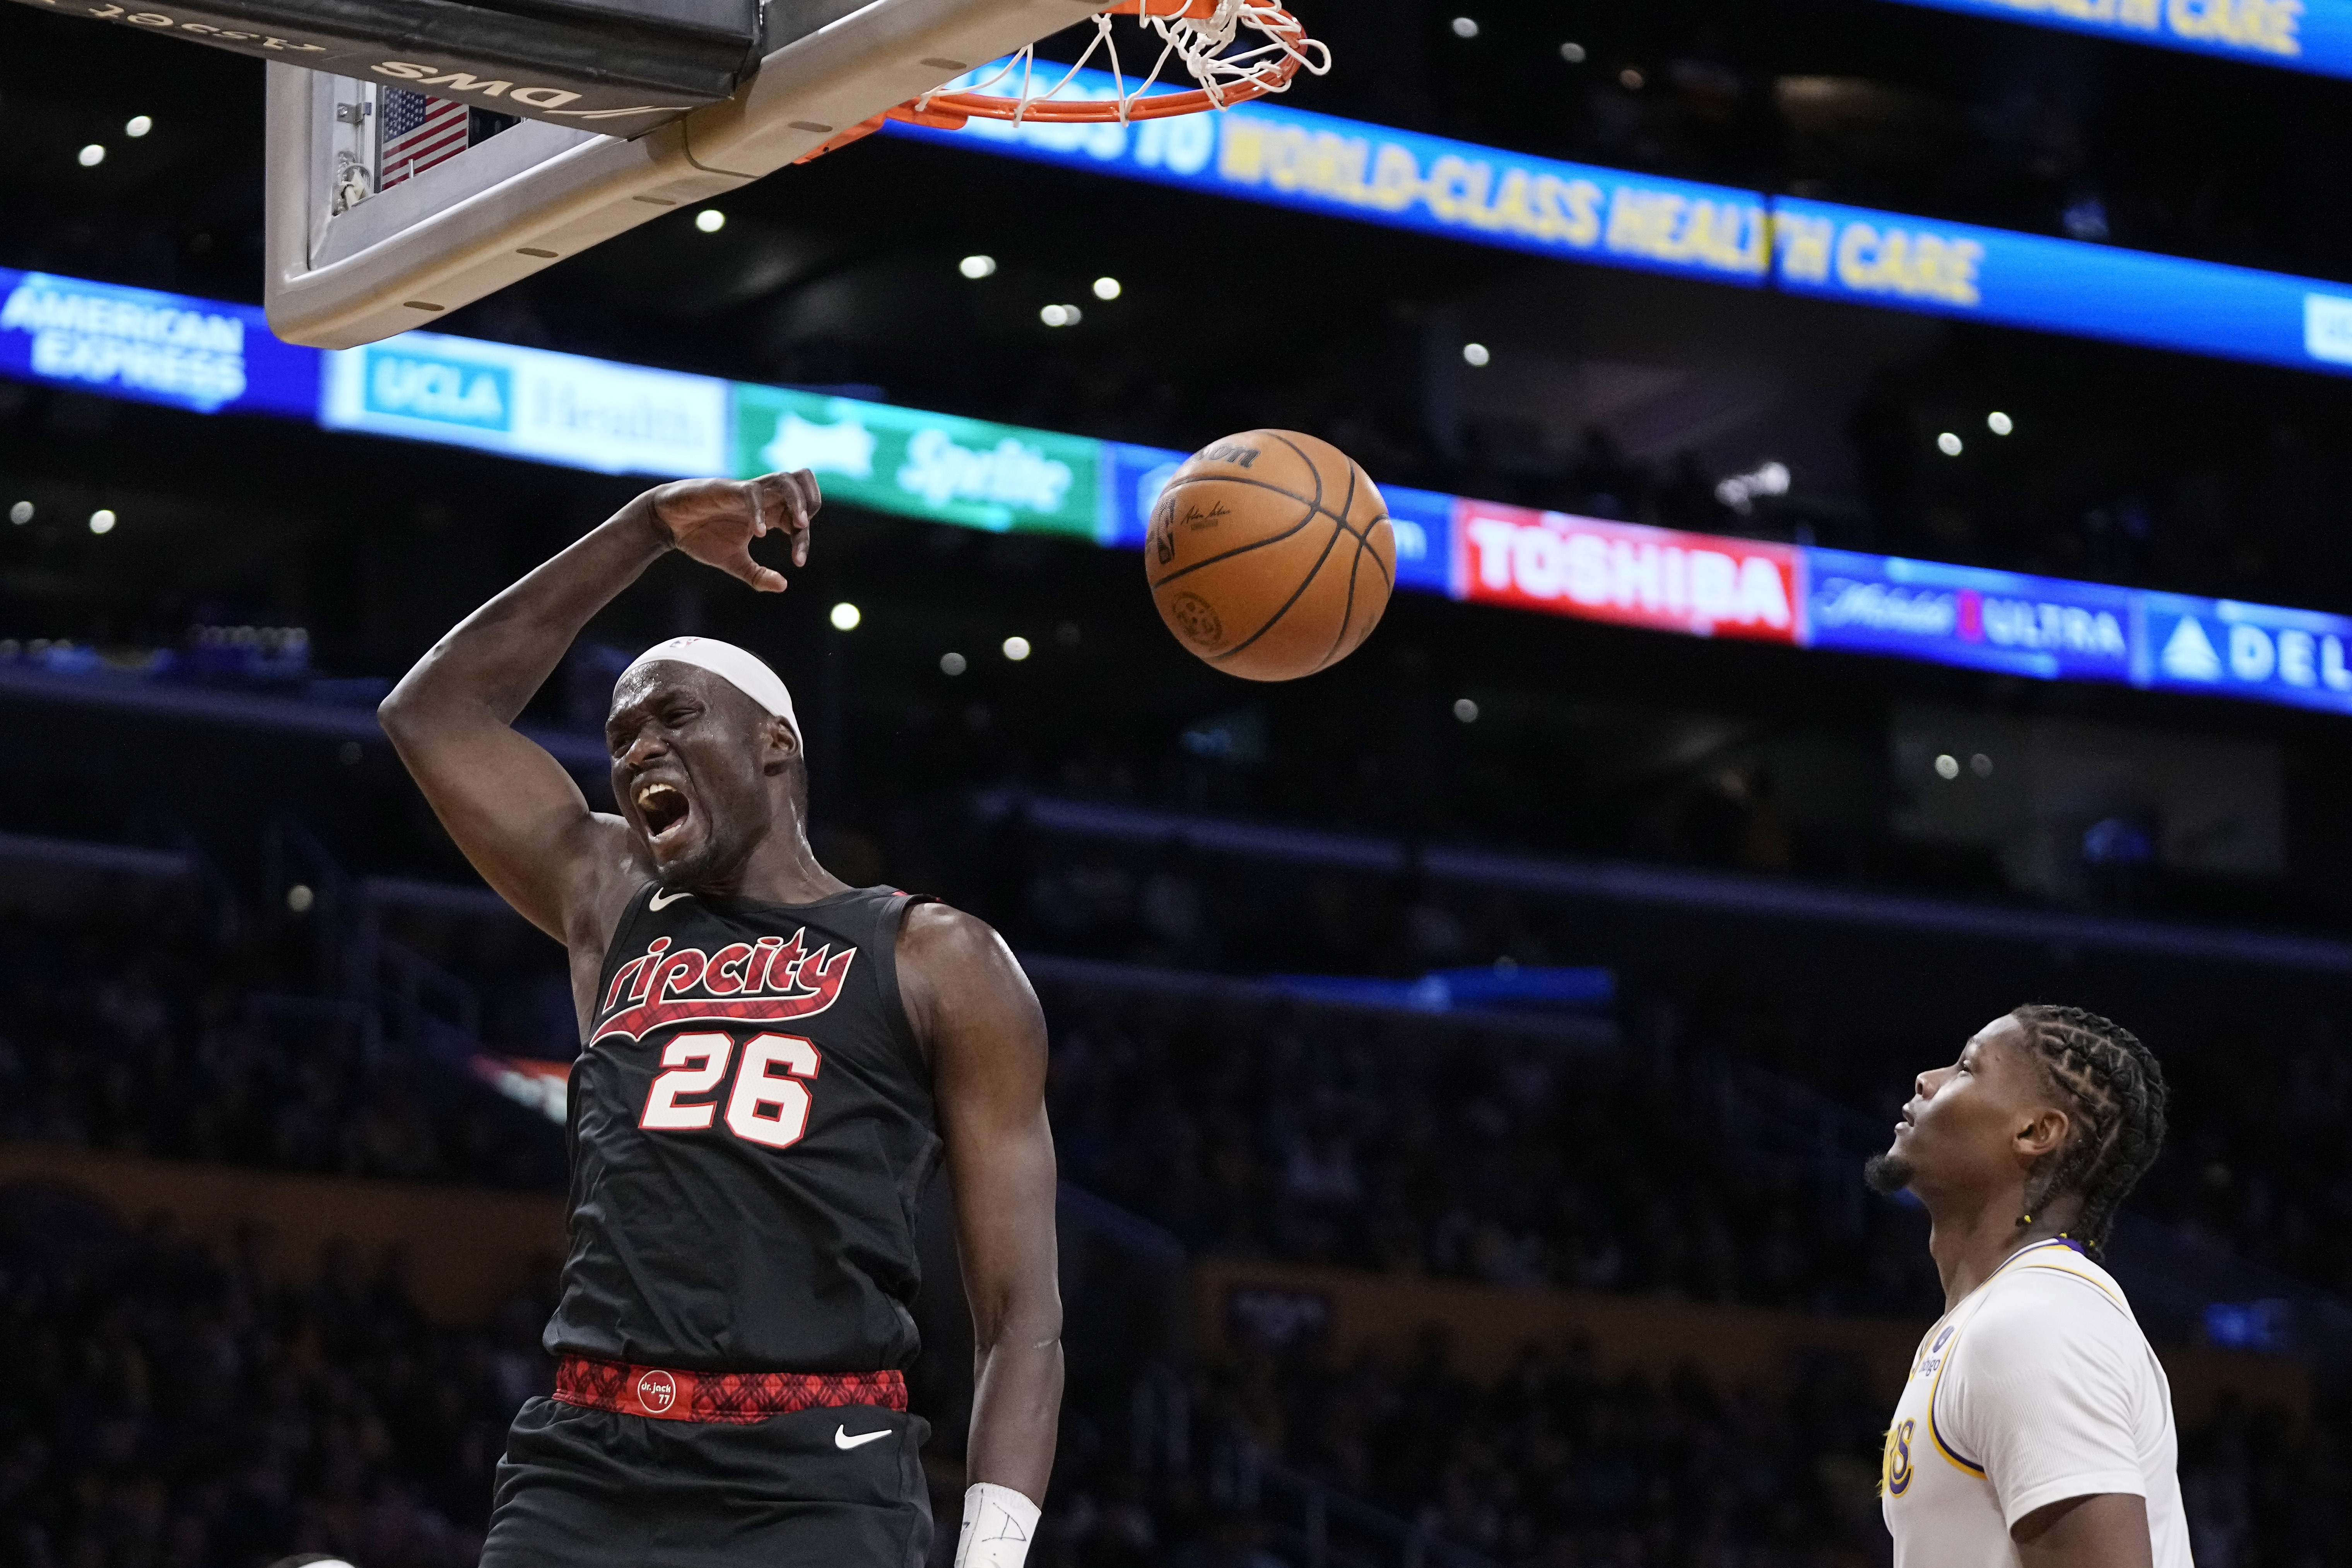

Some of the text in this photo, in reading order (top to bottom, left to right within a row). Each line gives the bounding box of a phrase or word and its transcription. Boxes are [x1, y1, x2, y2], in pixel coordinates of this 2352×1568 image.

[88, 4, 583, 109] DWS Asset
[1218, 115, 1603, 247] WORLD-CLASS
[1837, 222, 1984, 306] CARE
[1, 286, 244, 354] AMERICAN
[31, 328, 246, 398] EXPRESS
[373, 354, 504, 420] UCLA
[897, 427, 1072, 513] Sprite
[1467, 515, 1790, 630] TOSHIBA
[1983, 596, 2126, 654] ULTRA
[2229, 623, 2352, 692] DEL
[590, 926, 857, 1047] ripcity
[639, 1030, 821, 1149] 26
[651, 1382, 671, 1394] jack
[658, 1394, 670, 1404] 77
